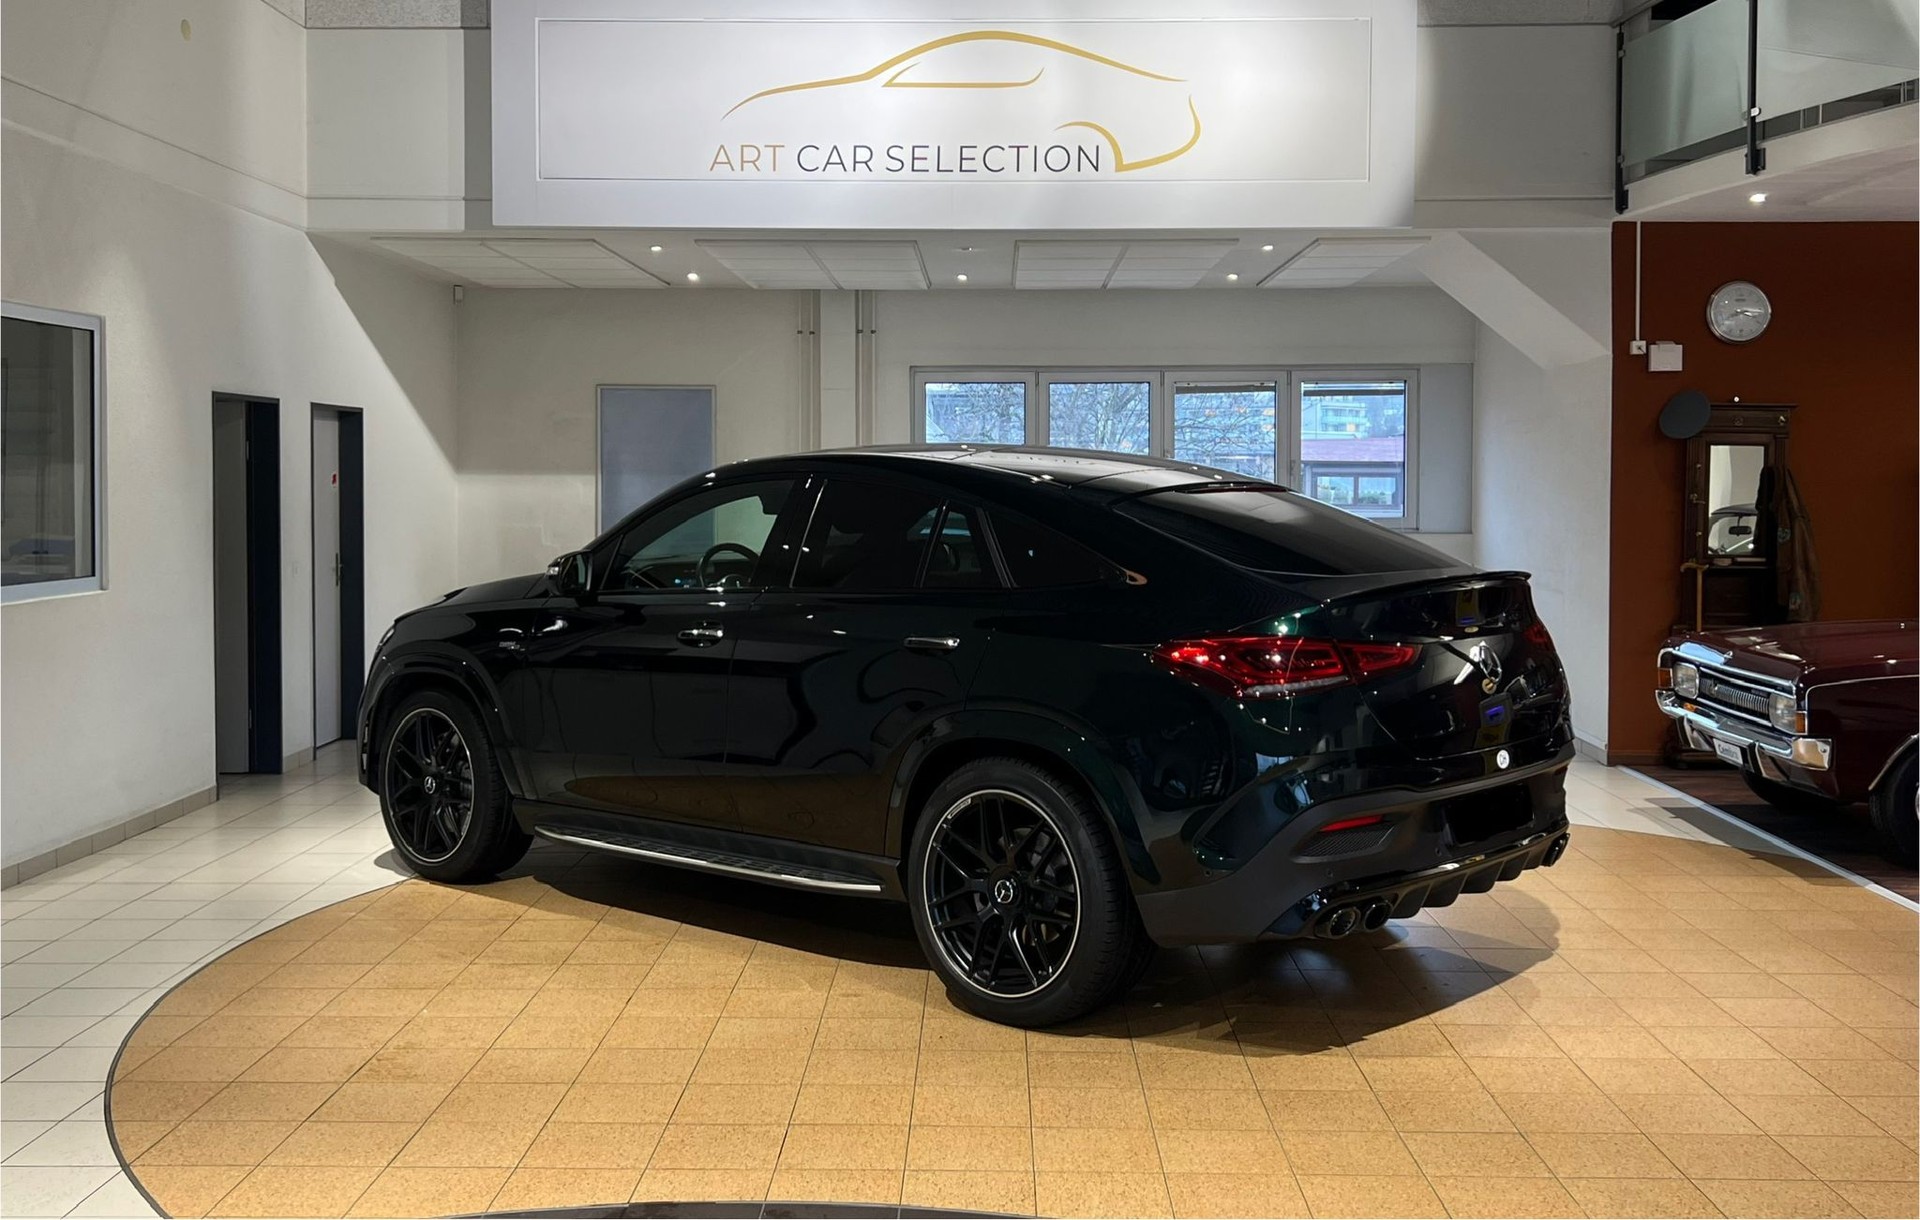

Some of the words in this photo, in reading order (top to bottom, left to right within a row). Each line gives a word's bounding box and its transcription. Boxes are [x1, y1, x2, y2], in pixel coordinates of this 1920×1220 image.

[709, 144, 785, 172] ART
[797, 144, 873, 172] CAR
[885, 144, 1100, 173] SELECTION
